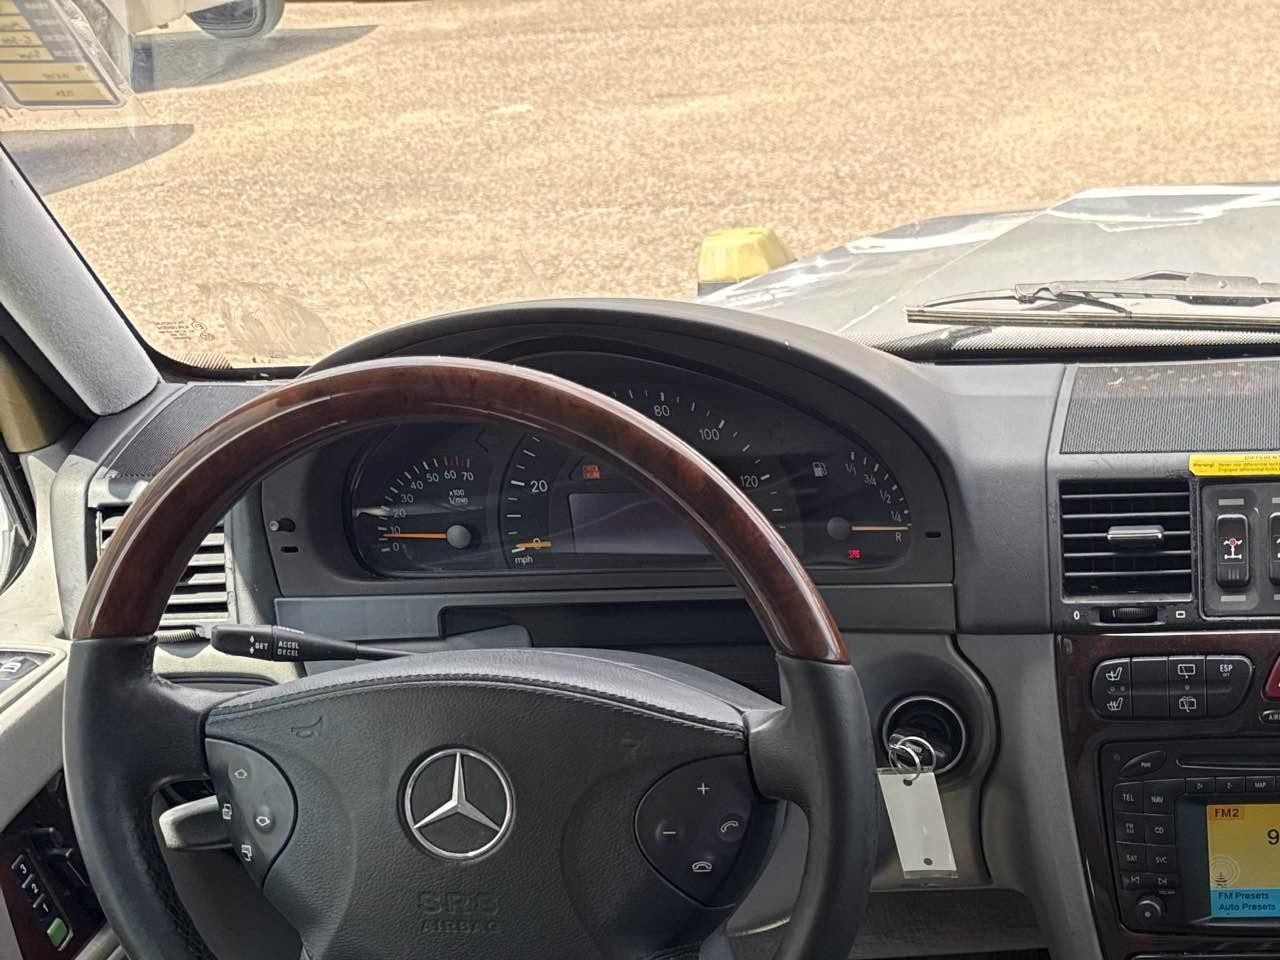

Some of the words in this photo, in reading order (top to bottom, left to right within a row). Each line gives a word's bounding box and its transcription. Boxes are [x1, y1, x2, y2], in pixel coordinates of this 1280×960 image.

[653, 404, 670, 417] 80
[699, 428, 720, 442] 100
[426, 473, 440, 482] 50
[443, 470, 457, 480] 60
[461, 471, 474, 481] 70
[410, 480, 424, 490] 40
[530, 480, 548, 493] 20
[740, 475, 759, 488] 120
[400, 493, 414, 504] 30
[392, 508, 407, 518] 20
[895, 531, 903, 542] R
[392, 543, 400, 552] 0
[514, 555, 534, 567] mph
[278, 640, 300, 650] ACCEL
[1219, 664, 1233, 673] ESP
[1123, 793, 1135, 802] TEL
[1150, 795, 1164, 804] NAV
[1214, 808, 1240, 818] FM2
[1154, 826, 1165, 834] CD
[1125, 854, 1138, 862] SAT
[1155, 856, 1168, 864] SVC
[19, 863, 27, 875] 3
[31, 882, 39, 894] 2
[1218, 891, 1233, 900] FM
[1236, 891, 1270, 900] Presets
[42, 902, 49, 913] 1
[1218, 902, 1240, 911] Auto
[1241, 902, 1277, 911] Presets
